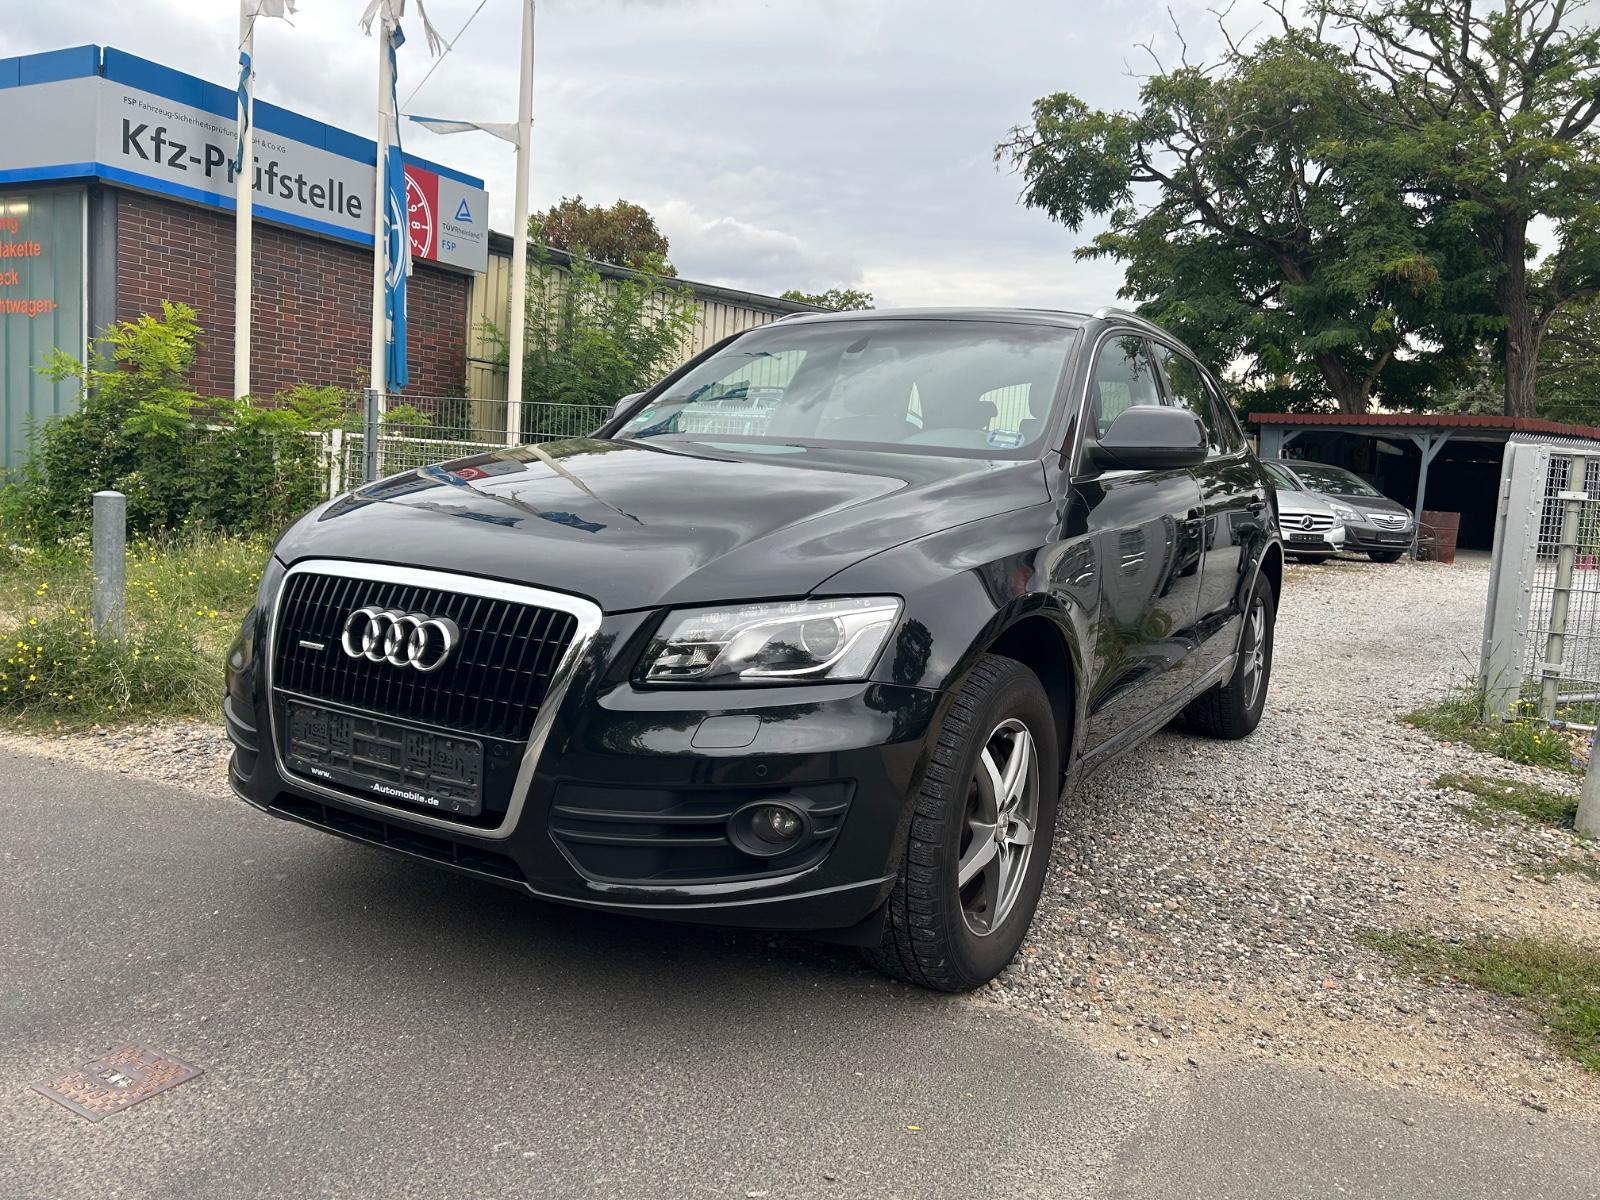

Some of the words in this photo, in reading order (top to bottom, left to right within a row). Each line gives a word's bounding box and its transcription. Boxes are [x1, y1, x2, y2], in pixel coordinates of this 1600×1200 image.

[123, 96, 137, 106] FSP
[442, 239, 457, 252] FSP
[310, 766, 332, 779] www.
